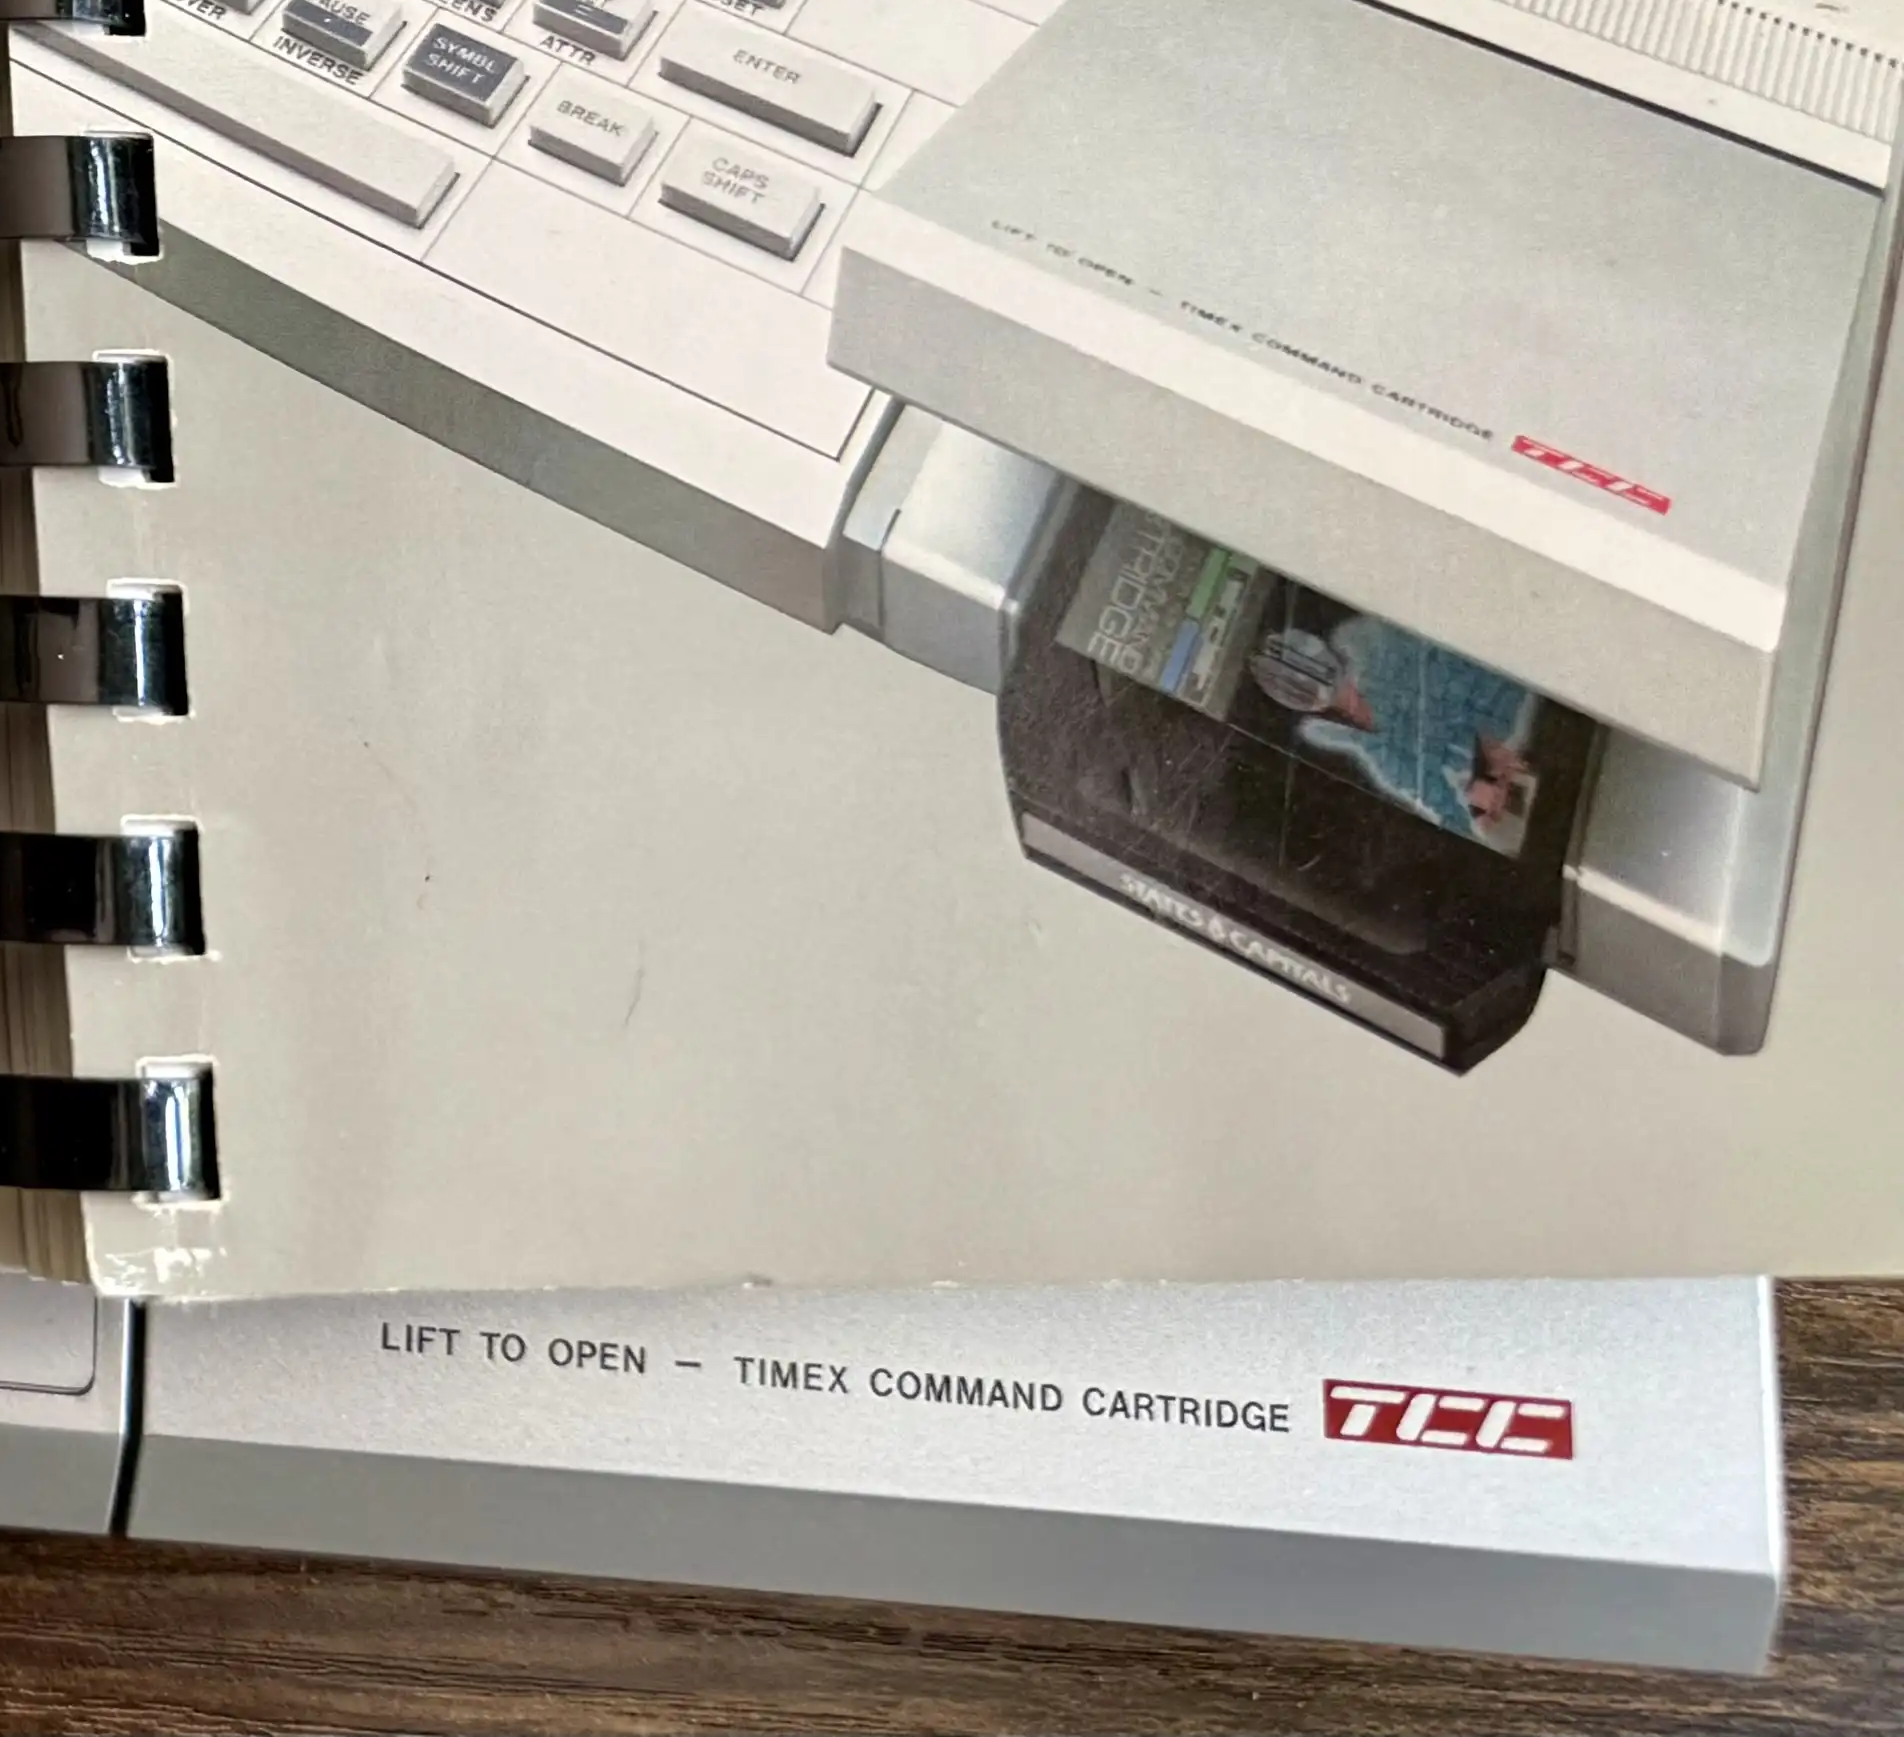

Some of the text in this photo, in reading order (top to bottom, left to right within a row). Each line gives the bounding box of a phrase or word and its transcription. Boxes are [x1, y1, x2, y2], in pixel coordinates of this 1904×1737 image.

[273, 37, 363, 85] INVERSE
[540, 36, 596, 66] ATTR
[733, 50, 801, 84] ENTER
[557, 101, 624, 136] BREAK
[702, 172, 766, 206] SHIFT
[712, 156, 770, 189] CAPS
[382, 1323, 460, 1355] LIFT
[480, 1333, 525, 1362] TO
[549, 1339, 644, 1373] OPEN
[734, 1357, 848, 1393] TIMEX
[870, 1368, 1062, 1411] COMMAND
[1083, 1388, 1289, 1432] CARTRIDGE
[1326, 1384, 1570, 1454] TCC
